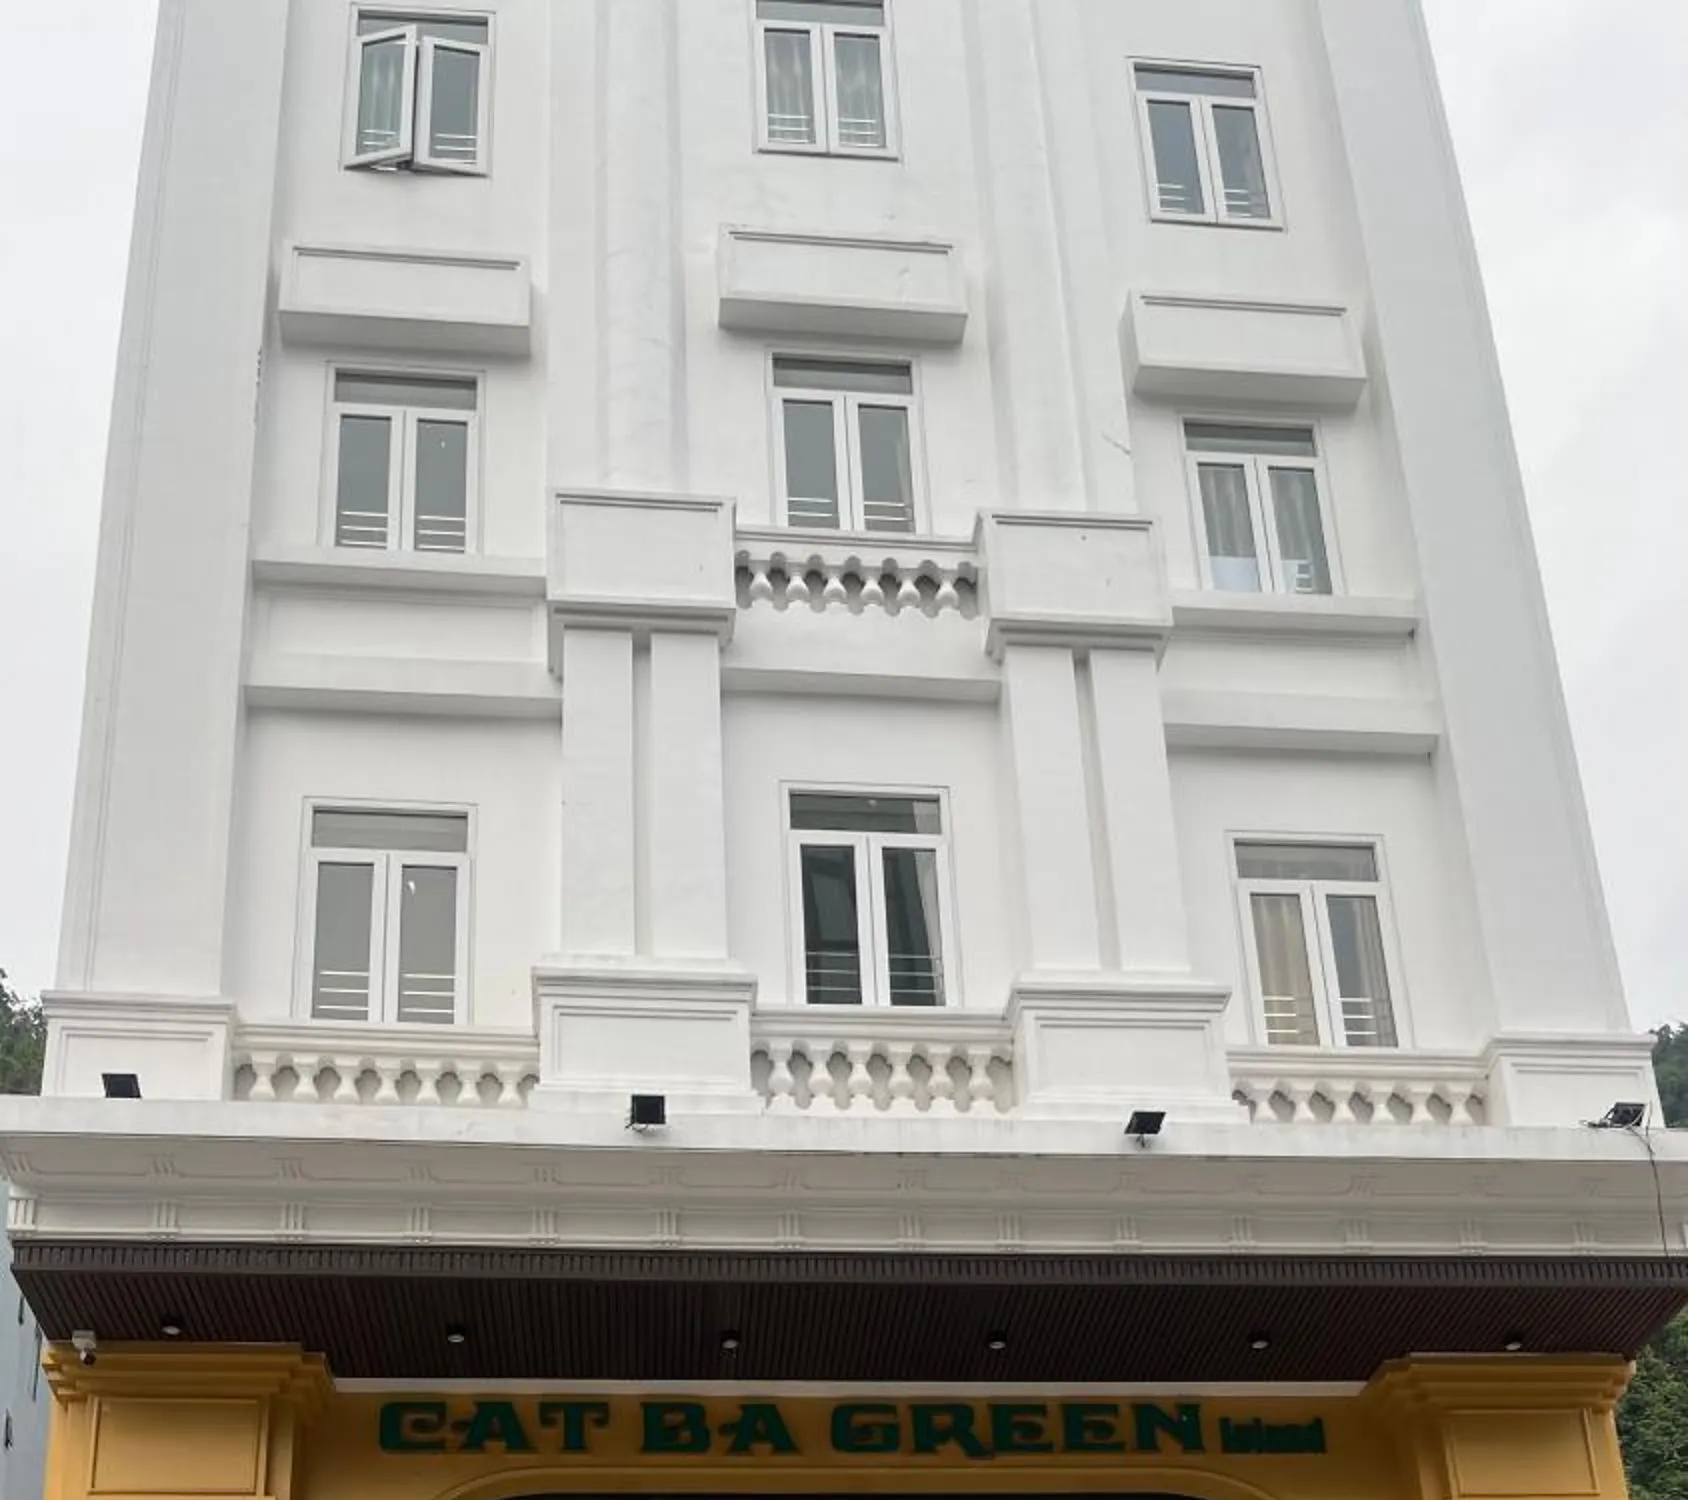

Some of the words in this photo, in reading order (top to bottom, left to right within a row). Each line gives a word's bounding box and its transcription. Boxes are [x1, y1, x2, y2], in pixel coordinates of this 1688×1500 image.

[379, 1401, 610, 1454] CAT
[640, 1402, 799, 1456] BA
[830, 1402, 1205, 1459] GREEN
